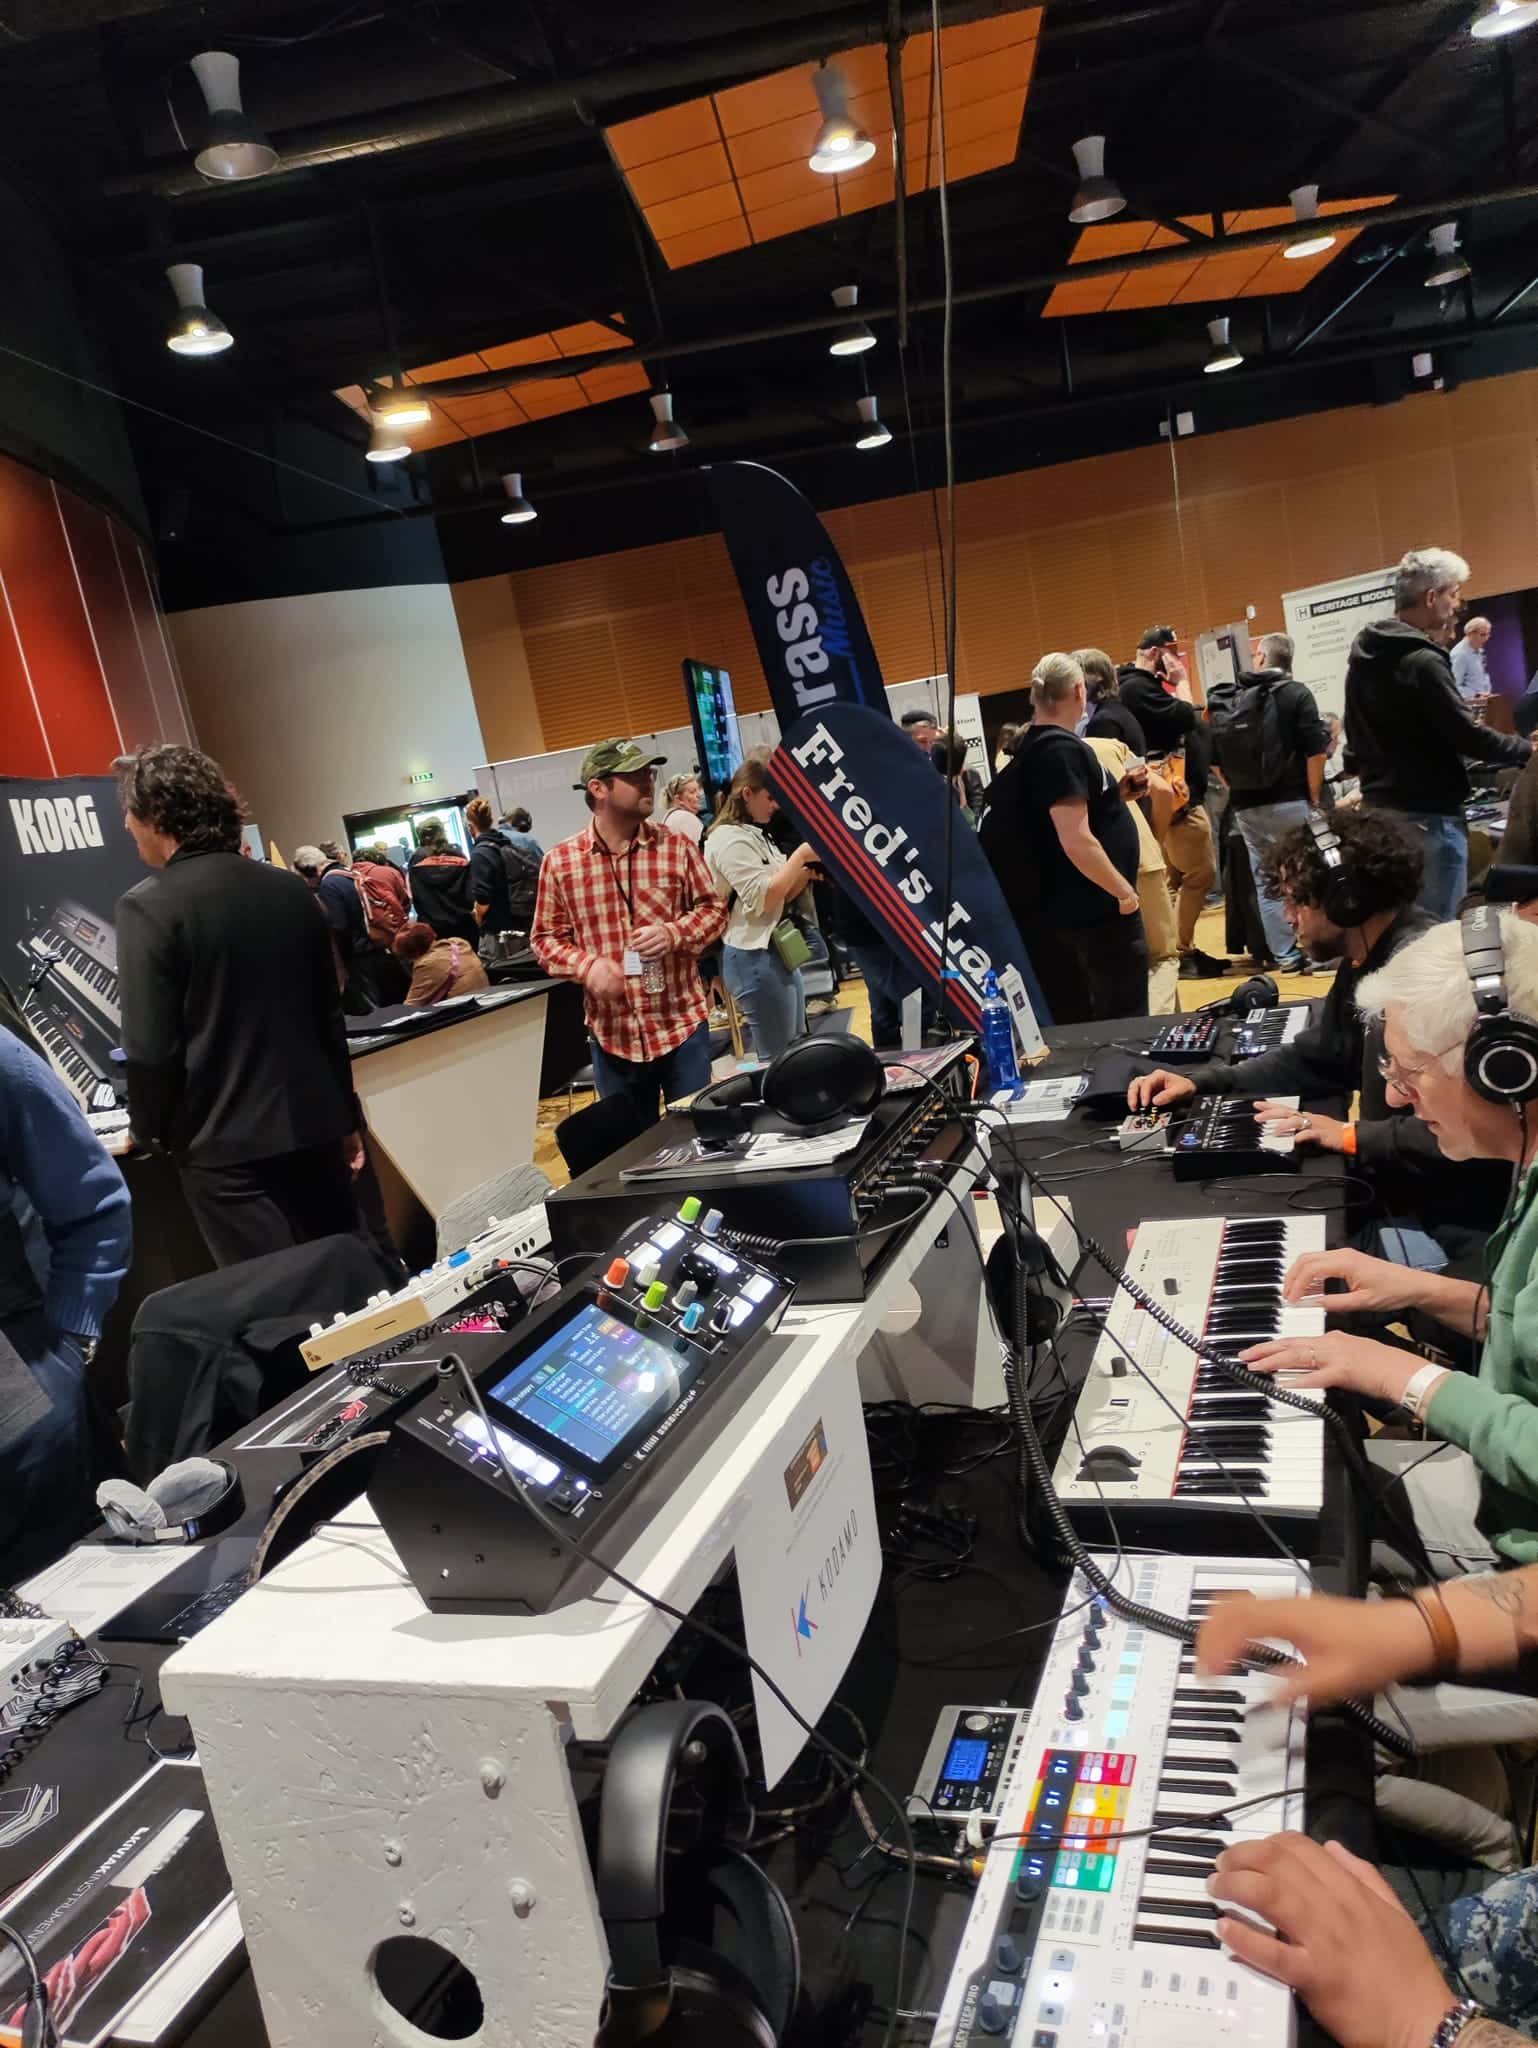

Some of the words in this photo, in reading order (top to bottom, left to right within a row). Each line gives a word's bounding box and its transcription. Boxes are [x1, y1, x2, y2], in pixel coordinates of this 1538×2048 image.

[766, 567, 837, 718] rass
[811, 557, 856, 657] Music
[1313, 596, 1361, 615] HERITAGE
[1361, 588, 1396, 604] MODUL
[8, 794, 105, 855] KORG
[791, 722, 933, 904] Fred's
[817, 1508, 859, 1601] KODAMO
[966, 1984, 981, 2006] PRO
